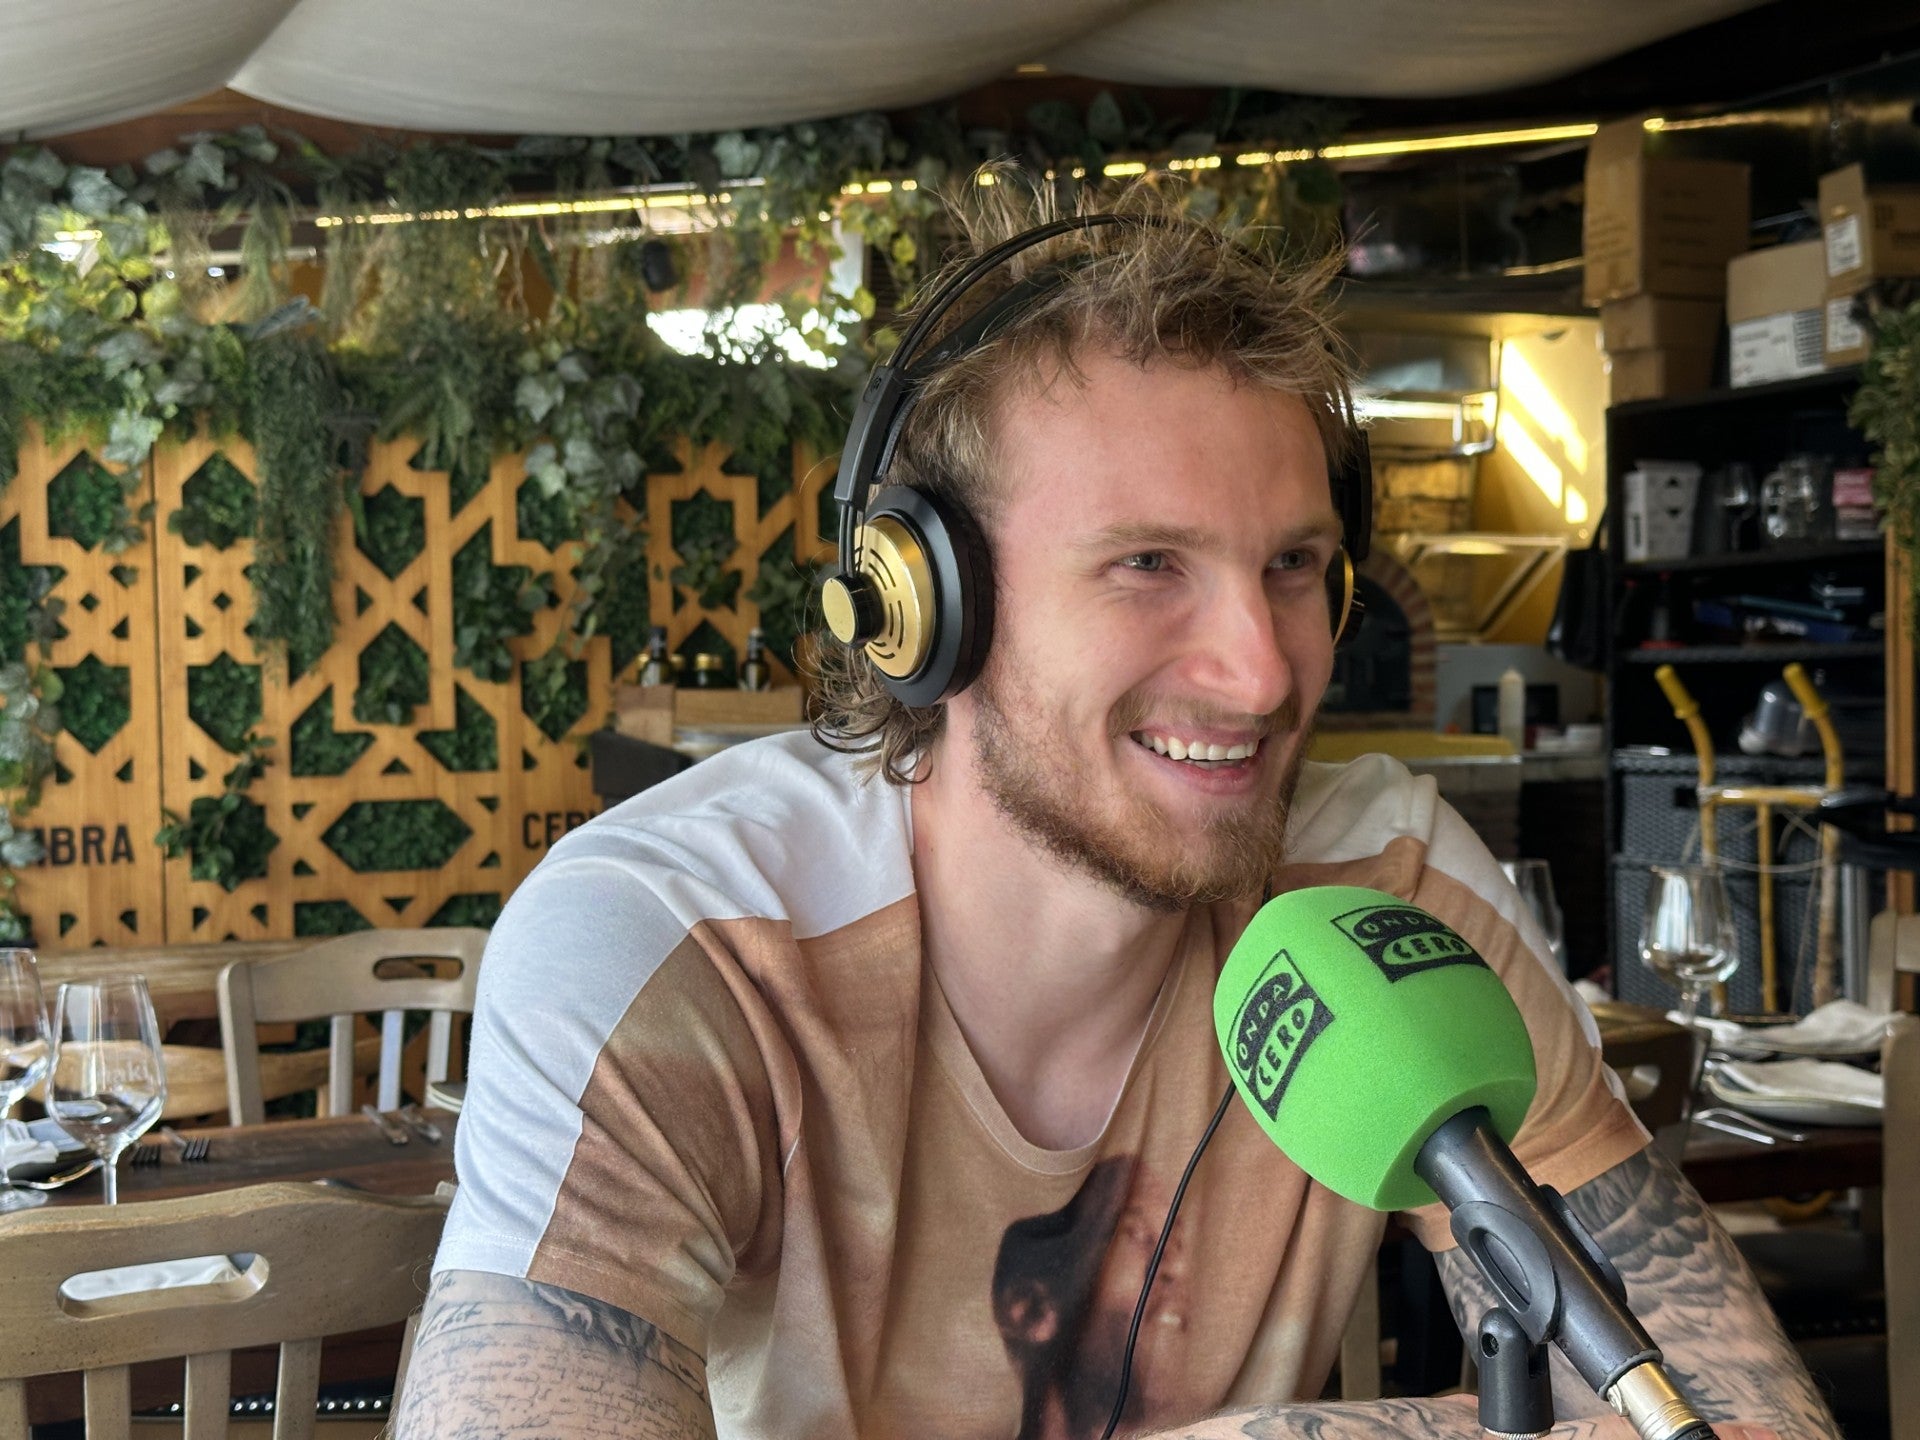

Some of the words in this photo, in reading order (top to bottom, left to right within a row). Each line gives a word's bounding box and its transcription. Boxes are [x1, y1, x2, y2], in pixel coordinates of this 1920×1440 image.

[1361, 915, 1439, 934] ONDA
[1392, 936, 1465, 959] CERO
[1238, 983, 1285, 1060] ONDA
[1258, 1007, 1305, 1087] CERO
